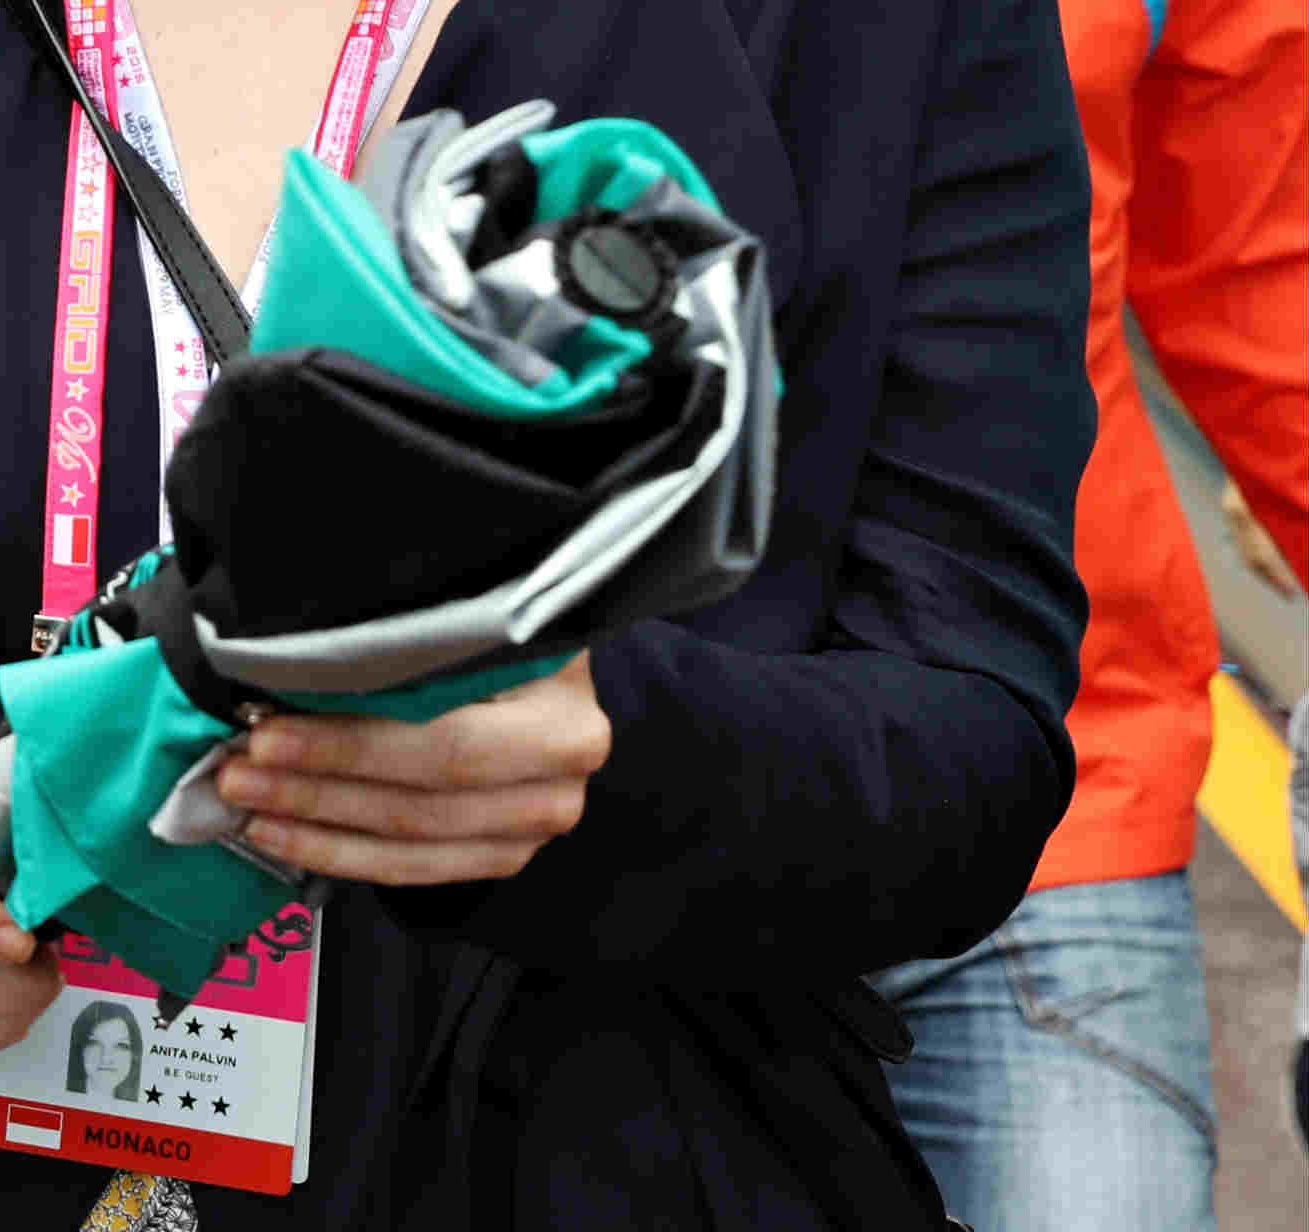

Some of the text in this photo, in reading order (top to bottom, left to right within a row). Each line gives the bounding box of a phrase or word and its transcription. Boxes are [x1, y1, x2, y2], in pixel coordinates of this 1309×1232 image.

[63, 230, 102, 374] GRID
[149, 1044, 237, 1068] ANITA PALVIN
[84, 1125, 192, 1162] MONACO
